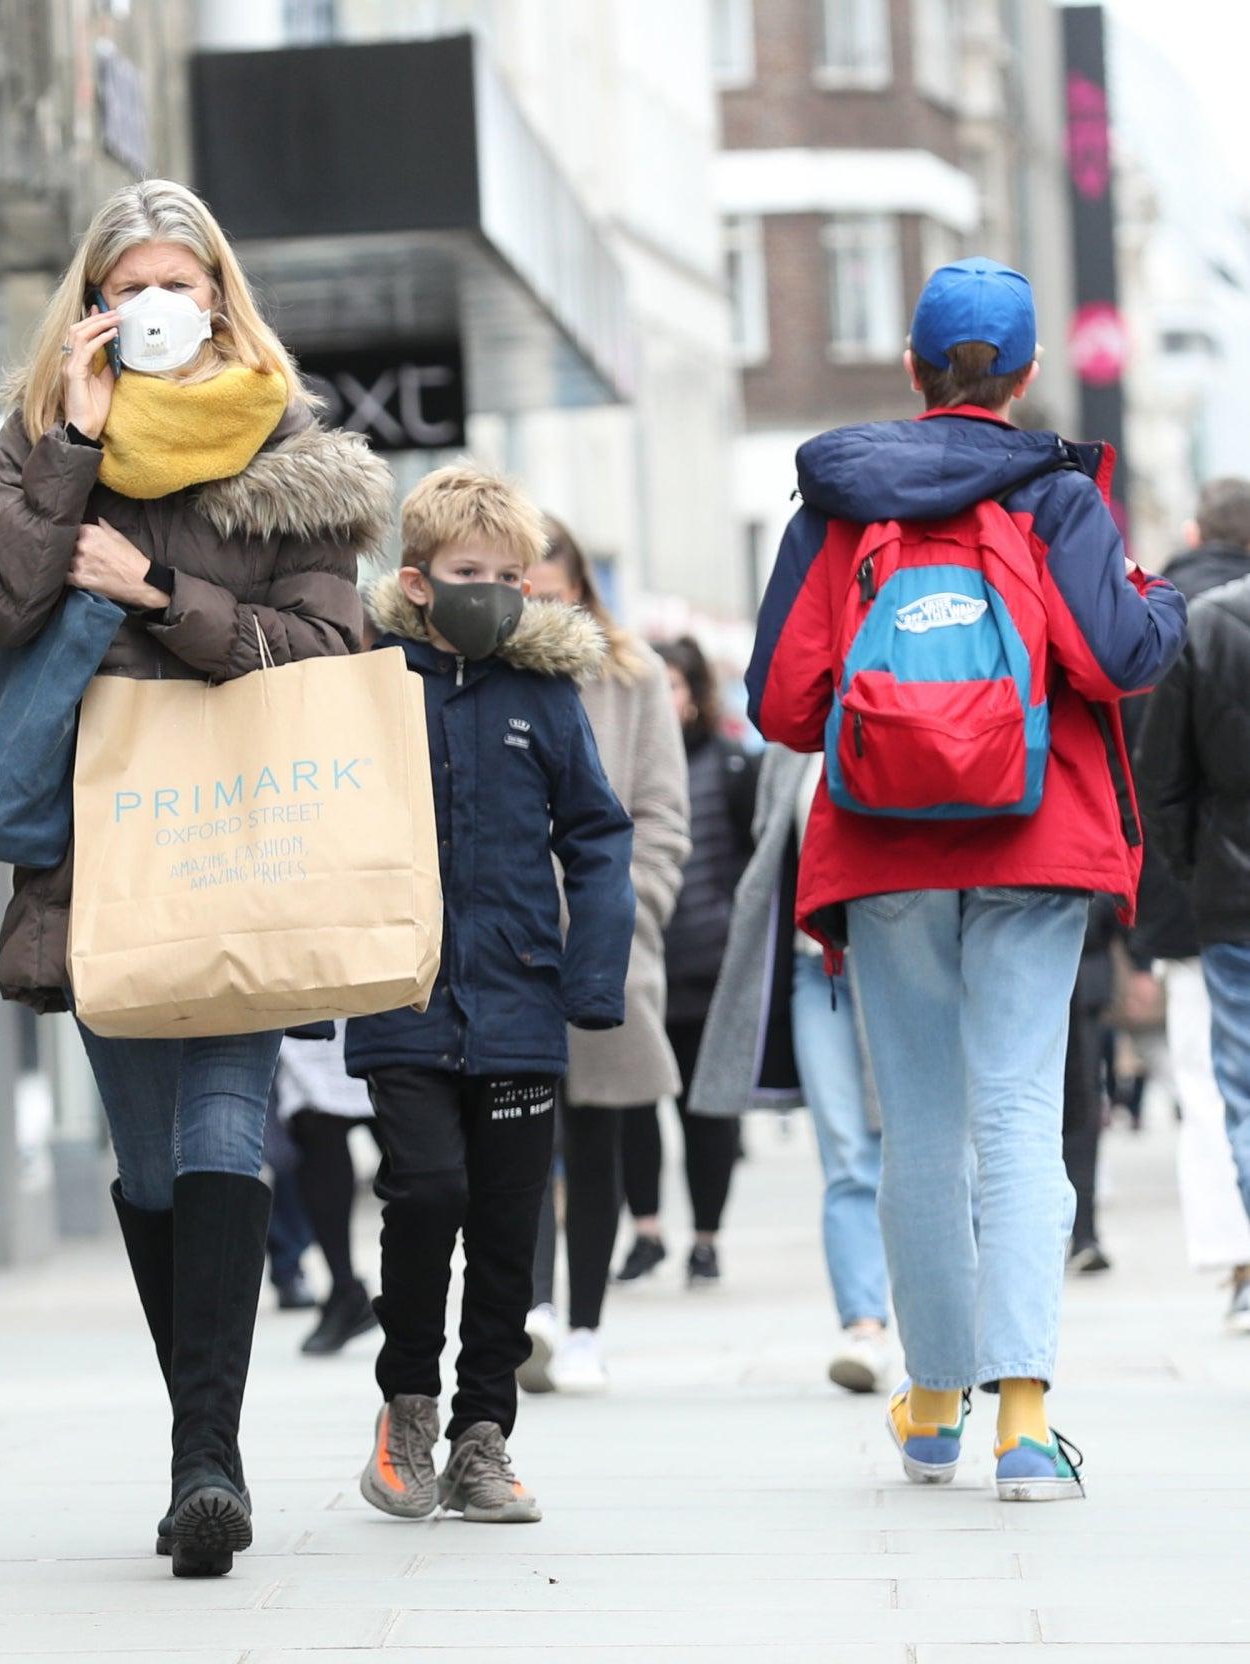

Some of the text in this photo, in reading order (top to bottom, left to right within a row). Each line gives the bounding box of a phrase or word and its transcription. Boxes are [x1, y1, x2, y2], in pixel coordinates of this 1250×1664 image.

[146, 327, 161, 336] 3M
[115, 757, 362, 823] PRIMARK
[155, 801, 324, 846] OXFORD STREET
[170, 835, 310, 879] AMAZING FASHION,
[190, 860, 307, 890] AMAZING PRICES
[491, 1107, 522, 1120] NEVER
